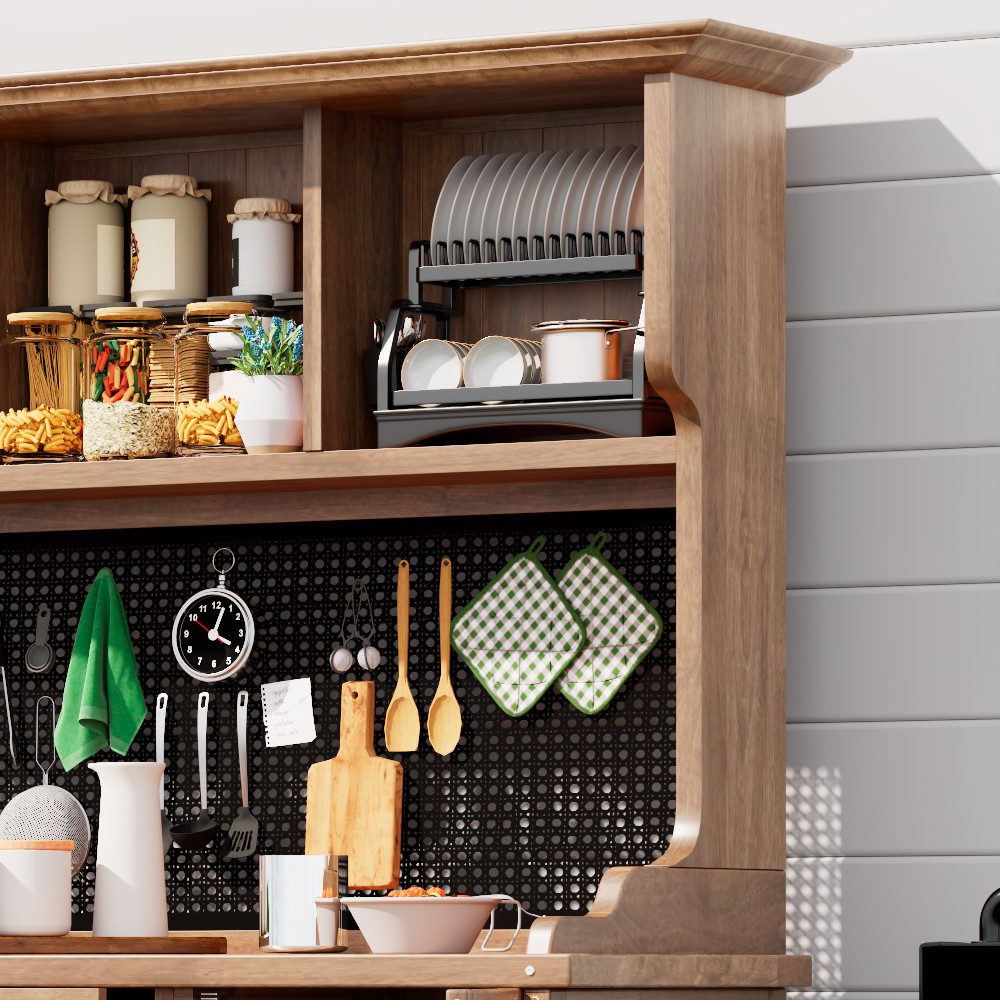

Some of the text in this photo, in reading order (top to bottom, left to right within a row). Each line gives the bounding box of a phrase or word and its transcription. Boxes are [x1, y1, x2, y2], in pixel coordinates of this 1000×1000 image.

[199, 604, 207, 612] 11
[212, 601, 222, 610] 12
[228, 604, 232, 612] 1
[188, 614, 198, 622] 10
[236, 612, 240, 620] 2
[184, 630, 190, 638] 9
[238, 629, 244, 637] 3
[186, 646, 192, 654] 8
[234, 646, 240, 654] 4
[197, 657, 202, 665] 7
[212, 660, 216, 668] 6
[226, 656, 232, 665] 5
